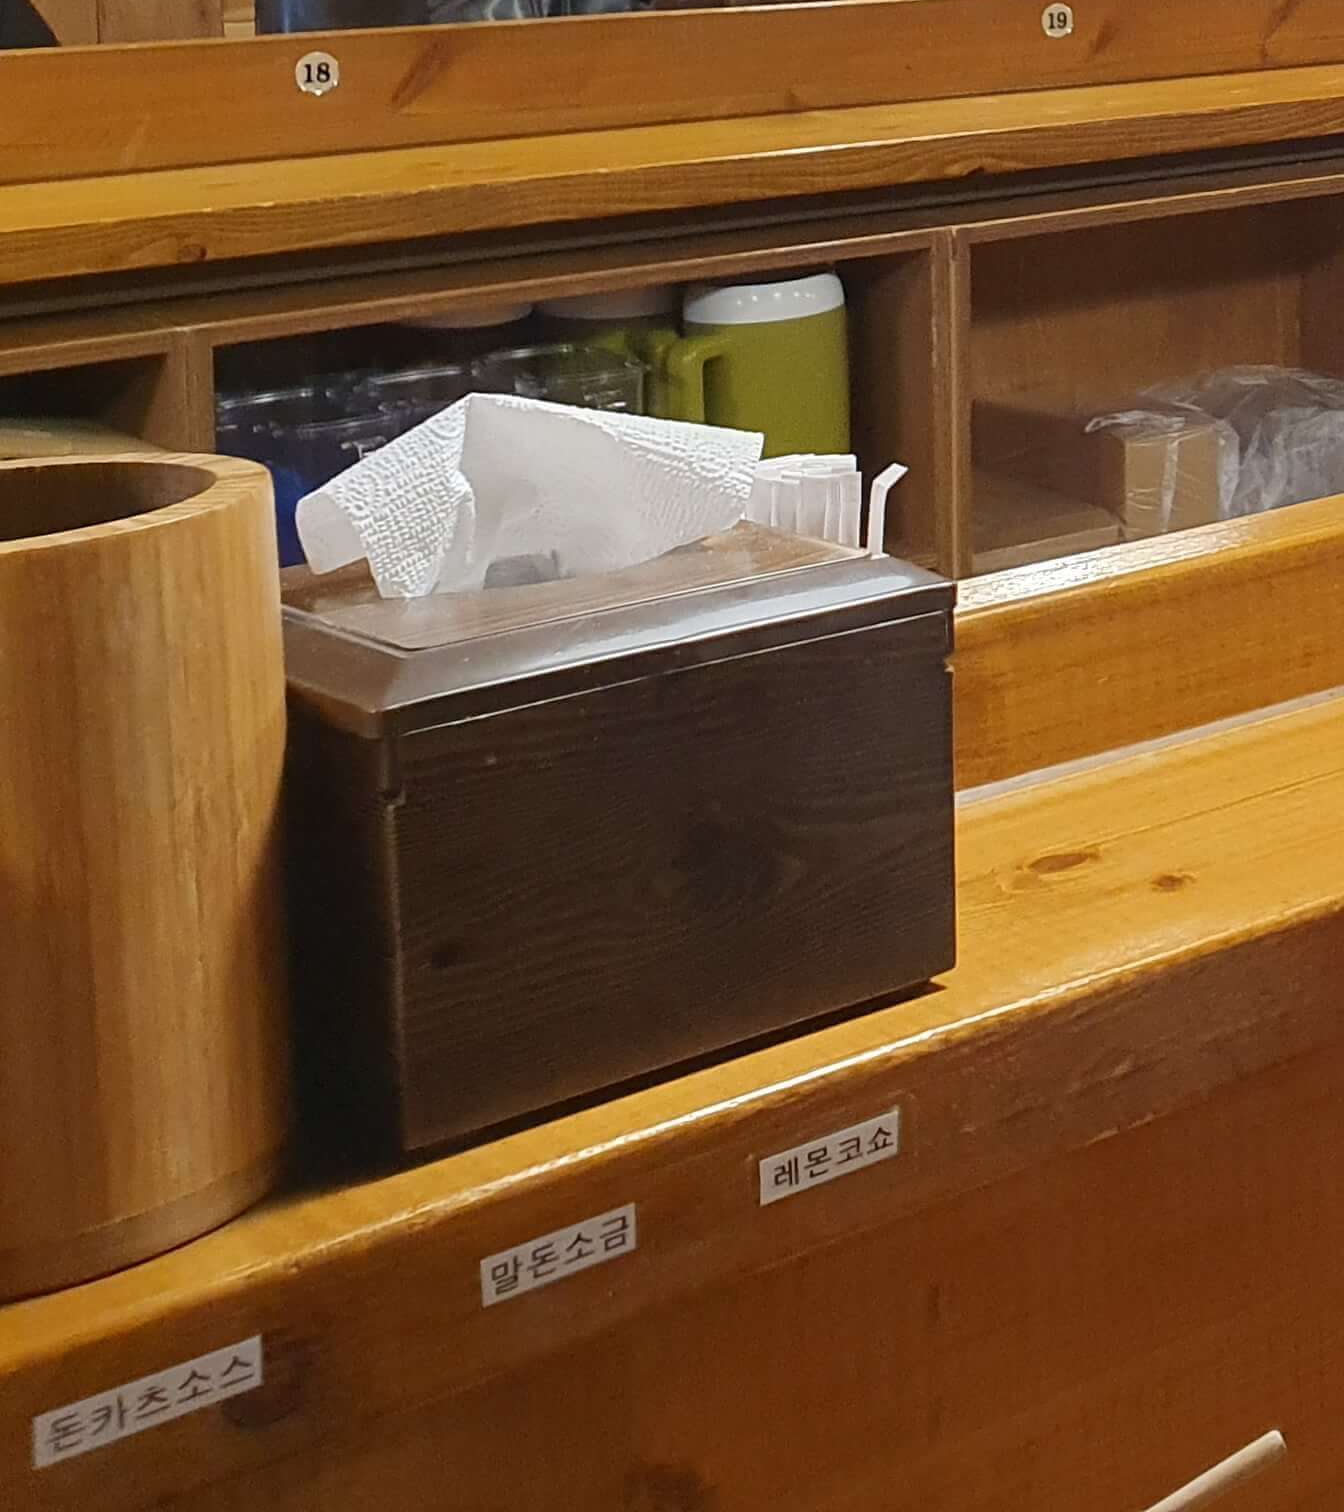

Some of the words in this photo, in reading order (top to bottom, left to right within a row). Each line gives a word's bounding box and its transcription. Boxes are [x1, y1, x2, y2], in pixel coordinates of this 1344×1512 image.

[1047, 11, 1068, 31] 19
[303, 62, 331, 84] 18
[772, 1126, 895, 1188] 레몬코쇼
[490, 1213, 634, 1295] 말돈소금
[46, 1354, 257, 1455] 돈카츠소스
